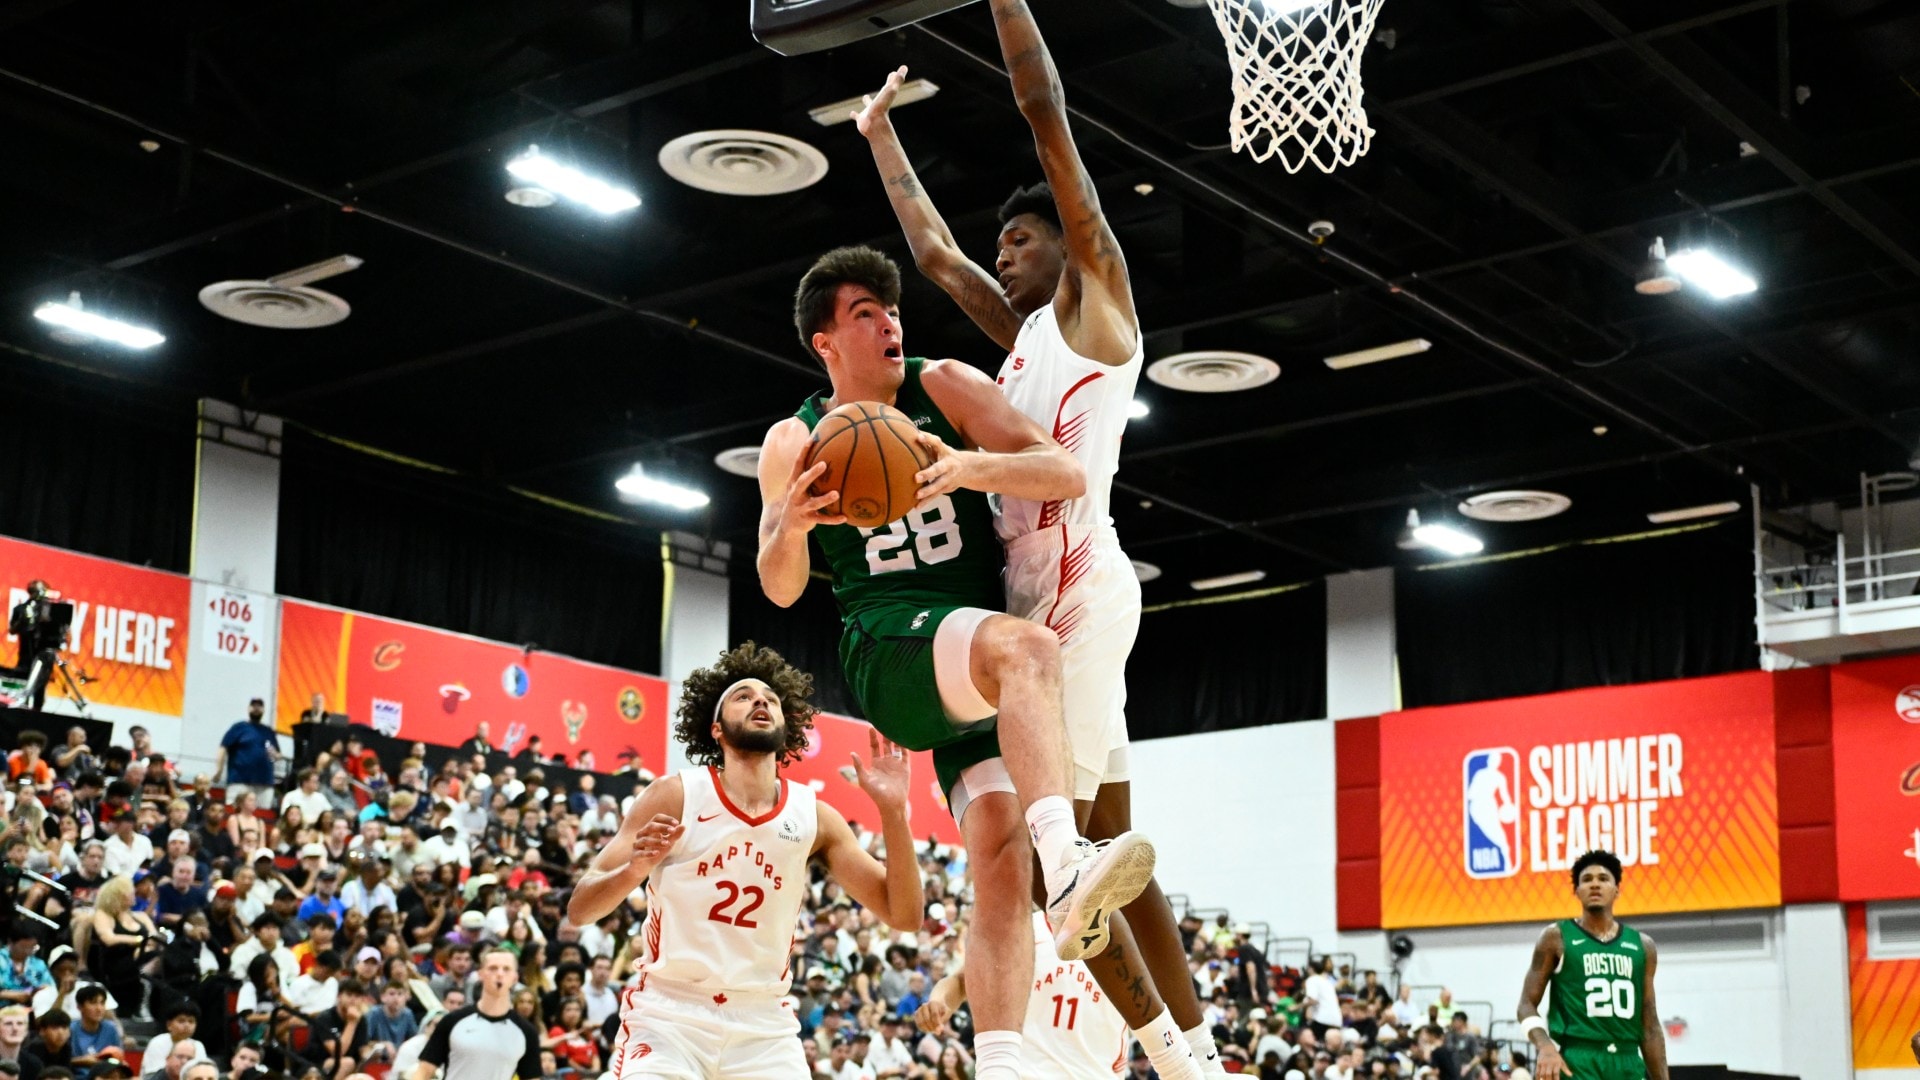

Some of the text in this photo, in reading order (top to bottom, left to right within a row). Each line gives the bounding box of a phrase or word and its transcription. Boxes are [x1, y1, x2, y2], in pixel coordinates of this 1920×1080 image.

[855, 493, 964, 576] 28
[219, 598, 252, 622] 106
[94, 604, 175, 670] HERE
[218, 631, 250, 654] 107
[1529, 733, 1684, 808] SUMMER
[1529, 800, 1660, 873] LEAGUE
[697, 842, 782, 890] RAPTORS
[1472, 847, 1500, 870] NBA
[708, 880, 765, 929] 22
[1034, 964, 1101, 1003] RAPTORS
[1583, 953, 1633, 979] BOSTON
[1051, 994, 1079, 1030] 11
[1584, 978, 1635, 1020] 20
